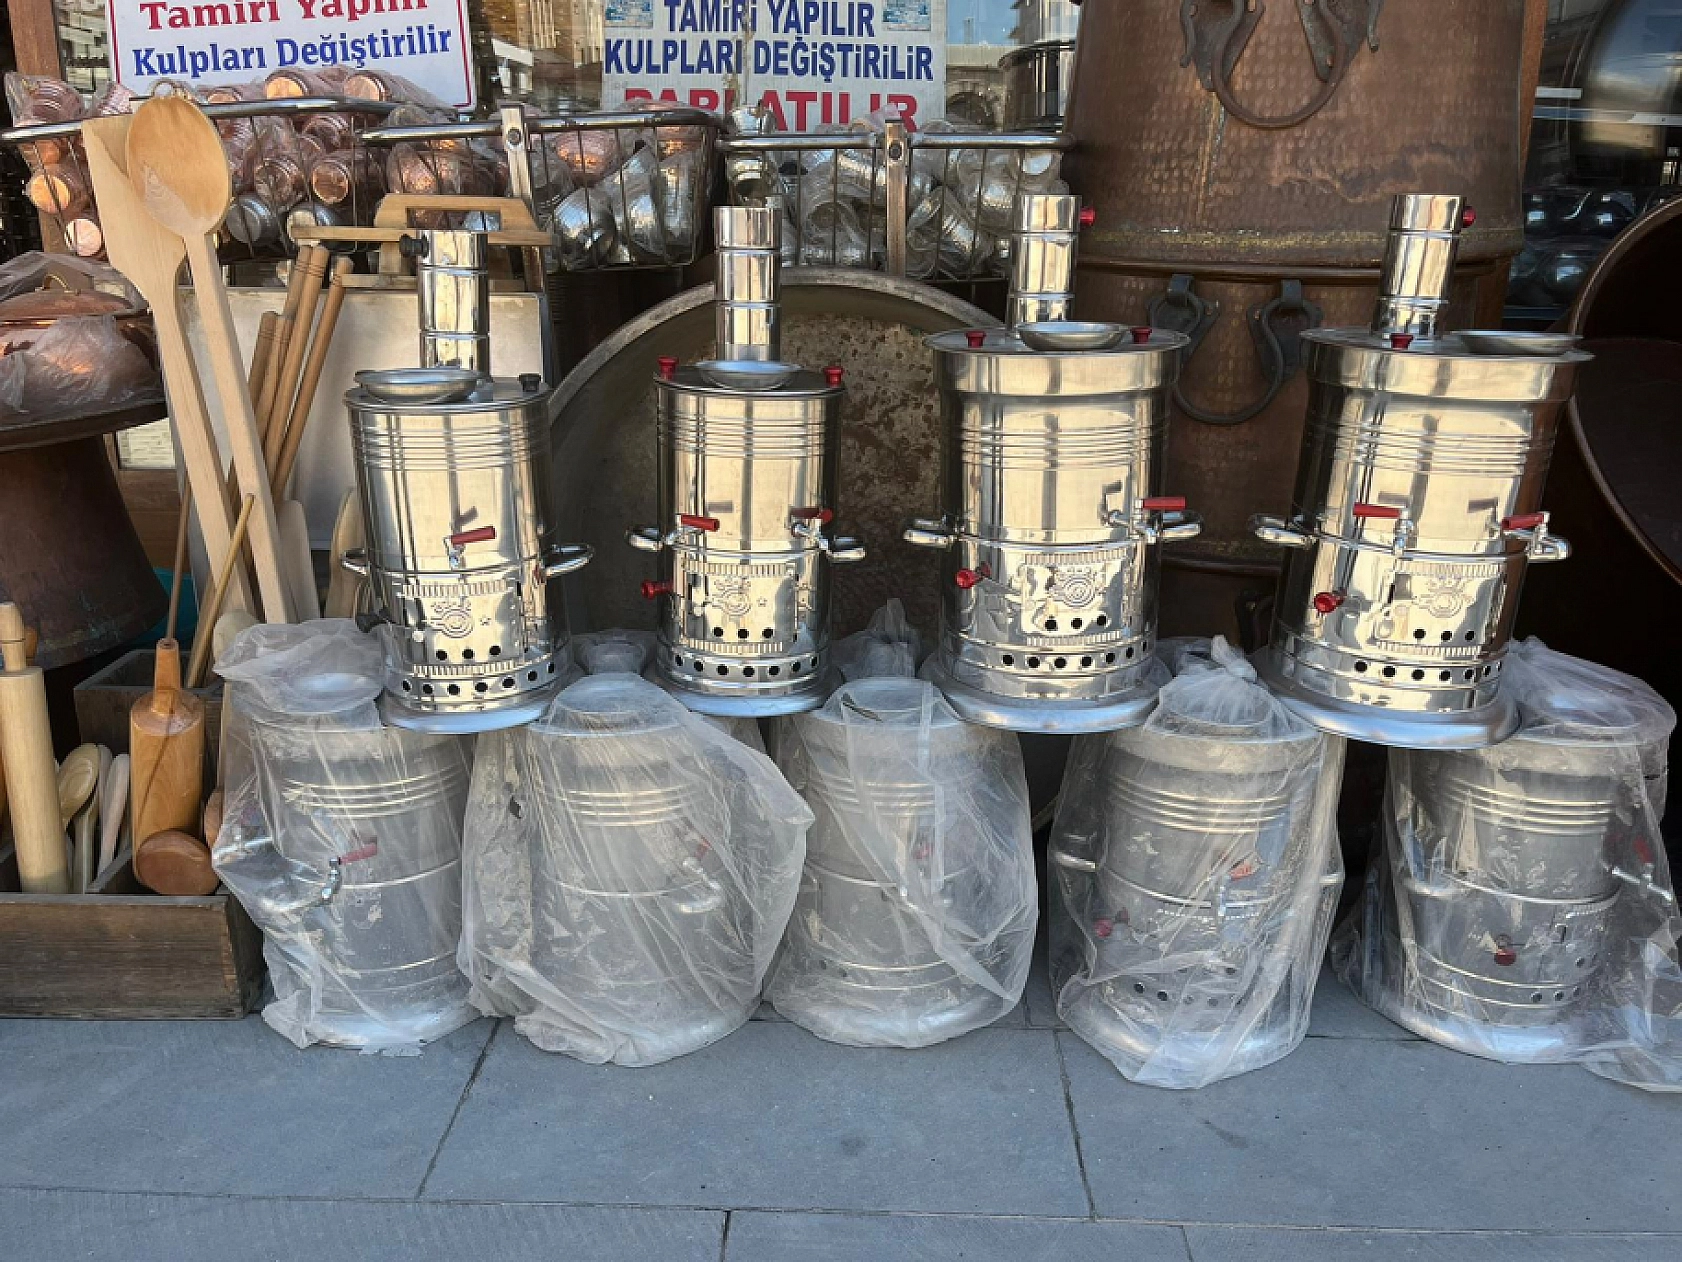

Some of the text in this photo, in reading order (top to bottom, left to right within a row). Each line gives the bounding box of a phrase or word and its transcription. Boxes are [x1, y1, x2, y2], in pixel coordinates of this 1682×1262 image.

[767, 0, 875, 37] YAPILIR
[132, 24, 451, 78] Kulpları Değiştirilir
[604, 38, 742, 75] KULPLARI
